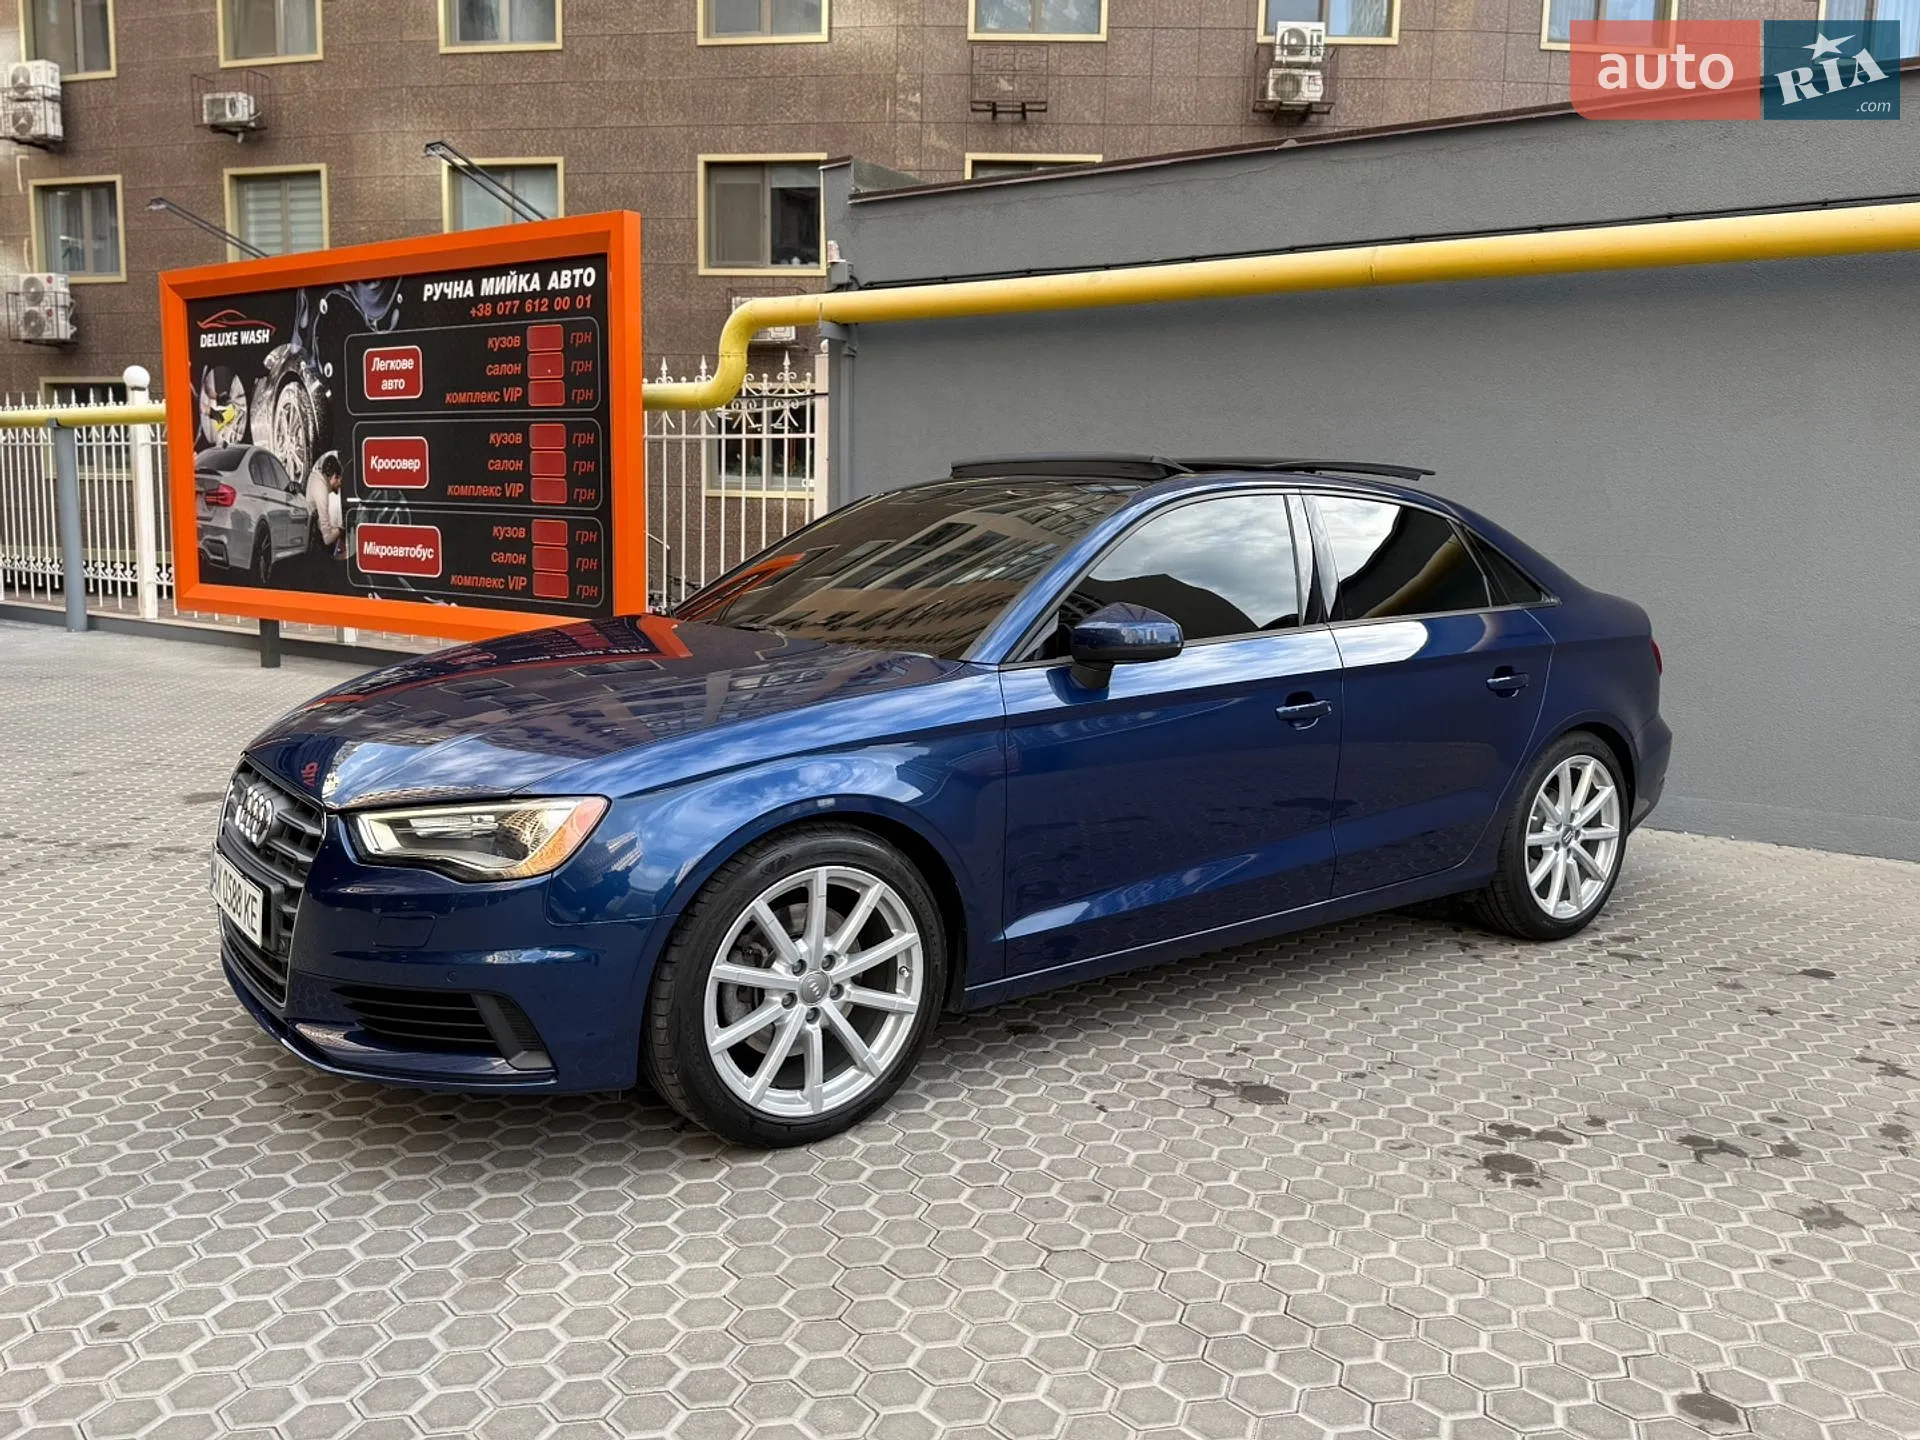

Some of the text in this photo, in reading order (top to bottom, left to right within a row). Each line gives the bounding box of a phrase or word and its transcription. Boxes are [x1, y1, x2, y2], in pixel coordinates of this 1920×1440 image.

[423, 267, 596, 301] РУЧНА МИЙКА АВТО
[470, 294, 592, 317] +38 077 612 00 01
[200, 329, 270, 348] DELUXE WASH
[487, 331, 592, 351] кузов грн
[371, 357, 414, 372] Легкове
[485, 360, 593, 376] салон грн
[381, 378, 405, 390] авто
[445, 386, 593, 404] комплекс VIP грн
[489, 432, 594, 447] кузов грн
[370, 455, 421, 471] Кросовер
[487, 459, 595, 475] салон грн
[447, 482, 595, 502] комплекс VIP грн
[492, 526, 597, 543] кузов грн
[363, 541, 434, 561] Мікроавтобус
[491, 551, 598, 571] салон грн
[450, 574, 598, 598] комплекс VIP грн
